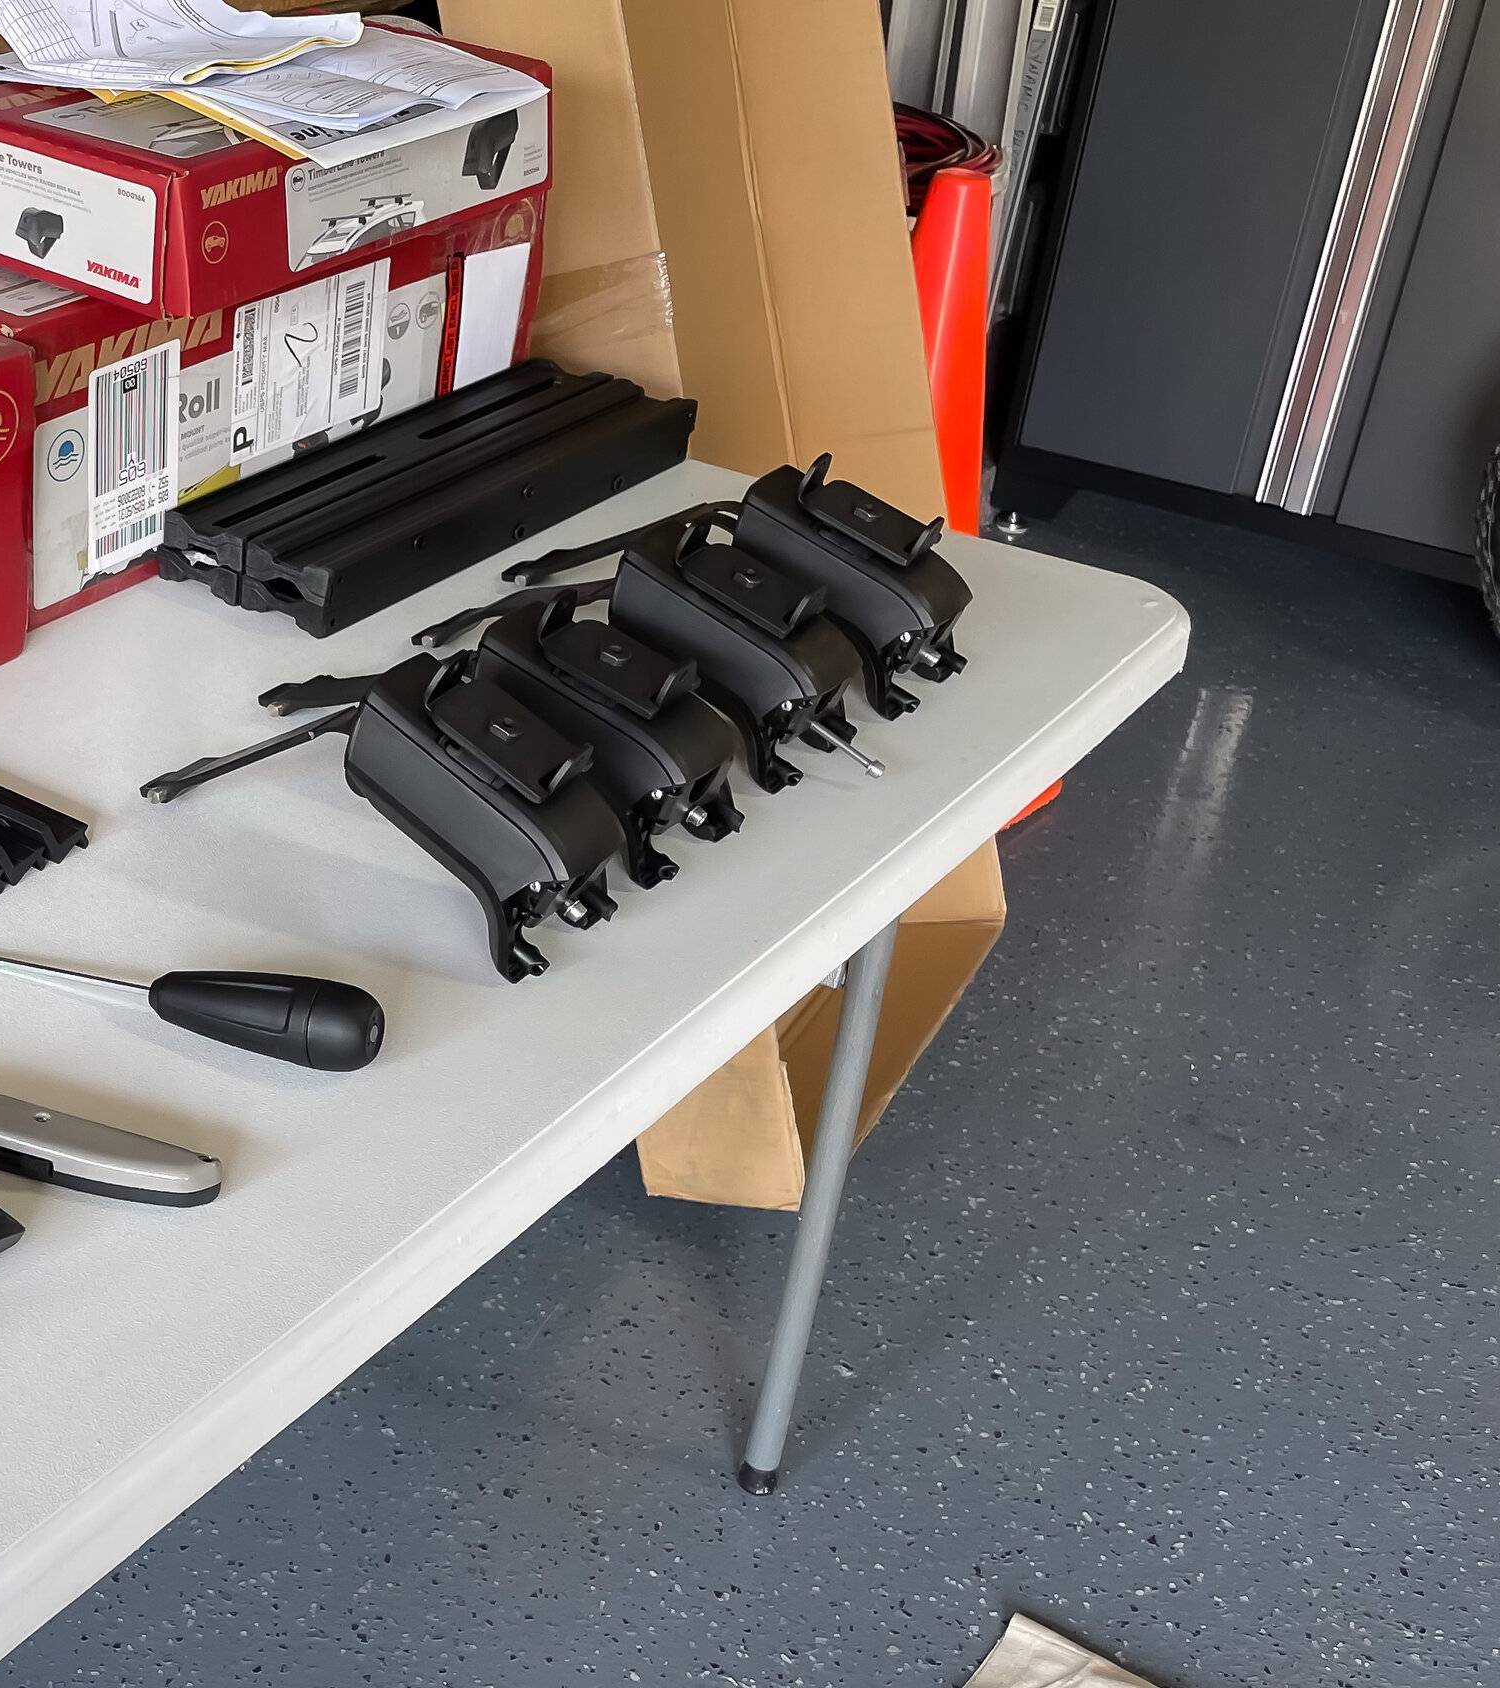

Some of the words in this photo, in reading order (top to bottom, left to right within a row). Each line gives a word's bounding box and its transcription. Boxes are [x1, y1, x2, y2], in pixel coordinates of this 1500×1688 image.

[6, 153, 43, 175] Towers
[200, 168, 279, 210] YAKIMA
[87, 260, 141, 289] YAKIMA
[35, 308, 224, 406] YAKIMA
[113, 358, 148, 381] 60504
[179, 377, 220, 424] Roll
[180, 425, 205, 440] MOUNT
[233, 426, 254, 453] P
[119, 462, 146, 486] 605
